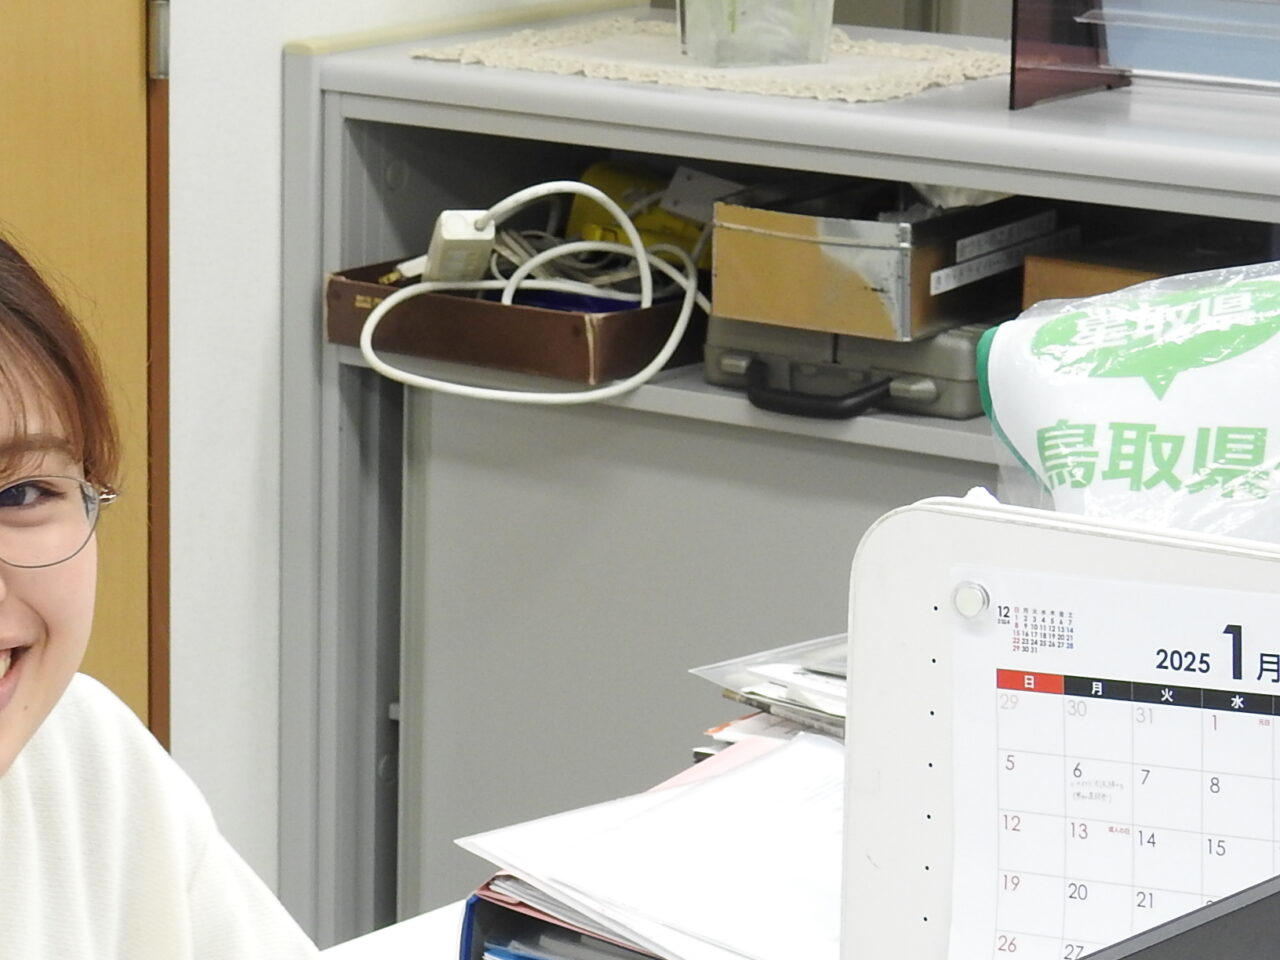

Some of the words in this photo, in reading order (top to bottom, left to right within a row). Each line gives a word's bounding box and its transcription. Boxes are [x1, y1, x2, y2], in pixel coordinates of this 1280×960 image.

[1037, 419, 1268, 499] 鳥取県
[997, 605, 1010, 618] 12
[1156, 649, 1210, 673] 2025
[1024, 675, 1035, 688] 日
[1091, 681, 1102, 696] 月
[1161, 688, 1174, 702] 火
[1231, 694, 1244, 709] 水
[1000, 693, 1019, 710] 29
[1067, 699, 1087, 717] 30
[1136, 707, 1153, 724] 31
[1212, 714, 1217, 730] 1
[1005, 754, 1015, 771] 5
[1073, 762, 1082, 778] 6
[1141, 769, 1151, 785] 7
[1210, 777, 1220, 794] 8
[1003, 814, 1021, 832] 12
[1071, 822, 1088, 840] 13
[1138, 830, 1156, 848] 14
[1208, 838, 1226, 856] 15
[1003, 874, 1020, 892] 19
[1068, 882, 1088, 901] 20
[1136, 891, 1153, 909] 21
[998, 935, 1017, 953] 26
[1064, 944, 1084, 960] 27
